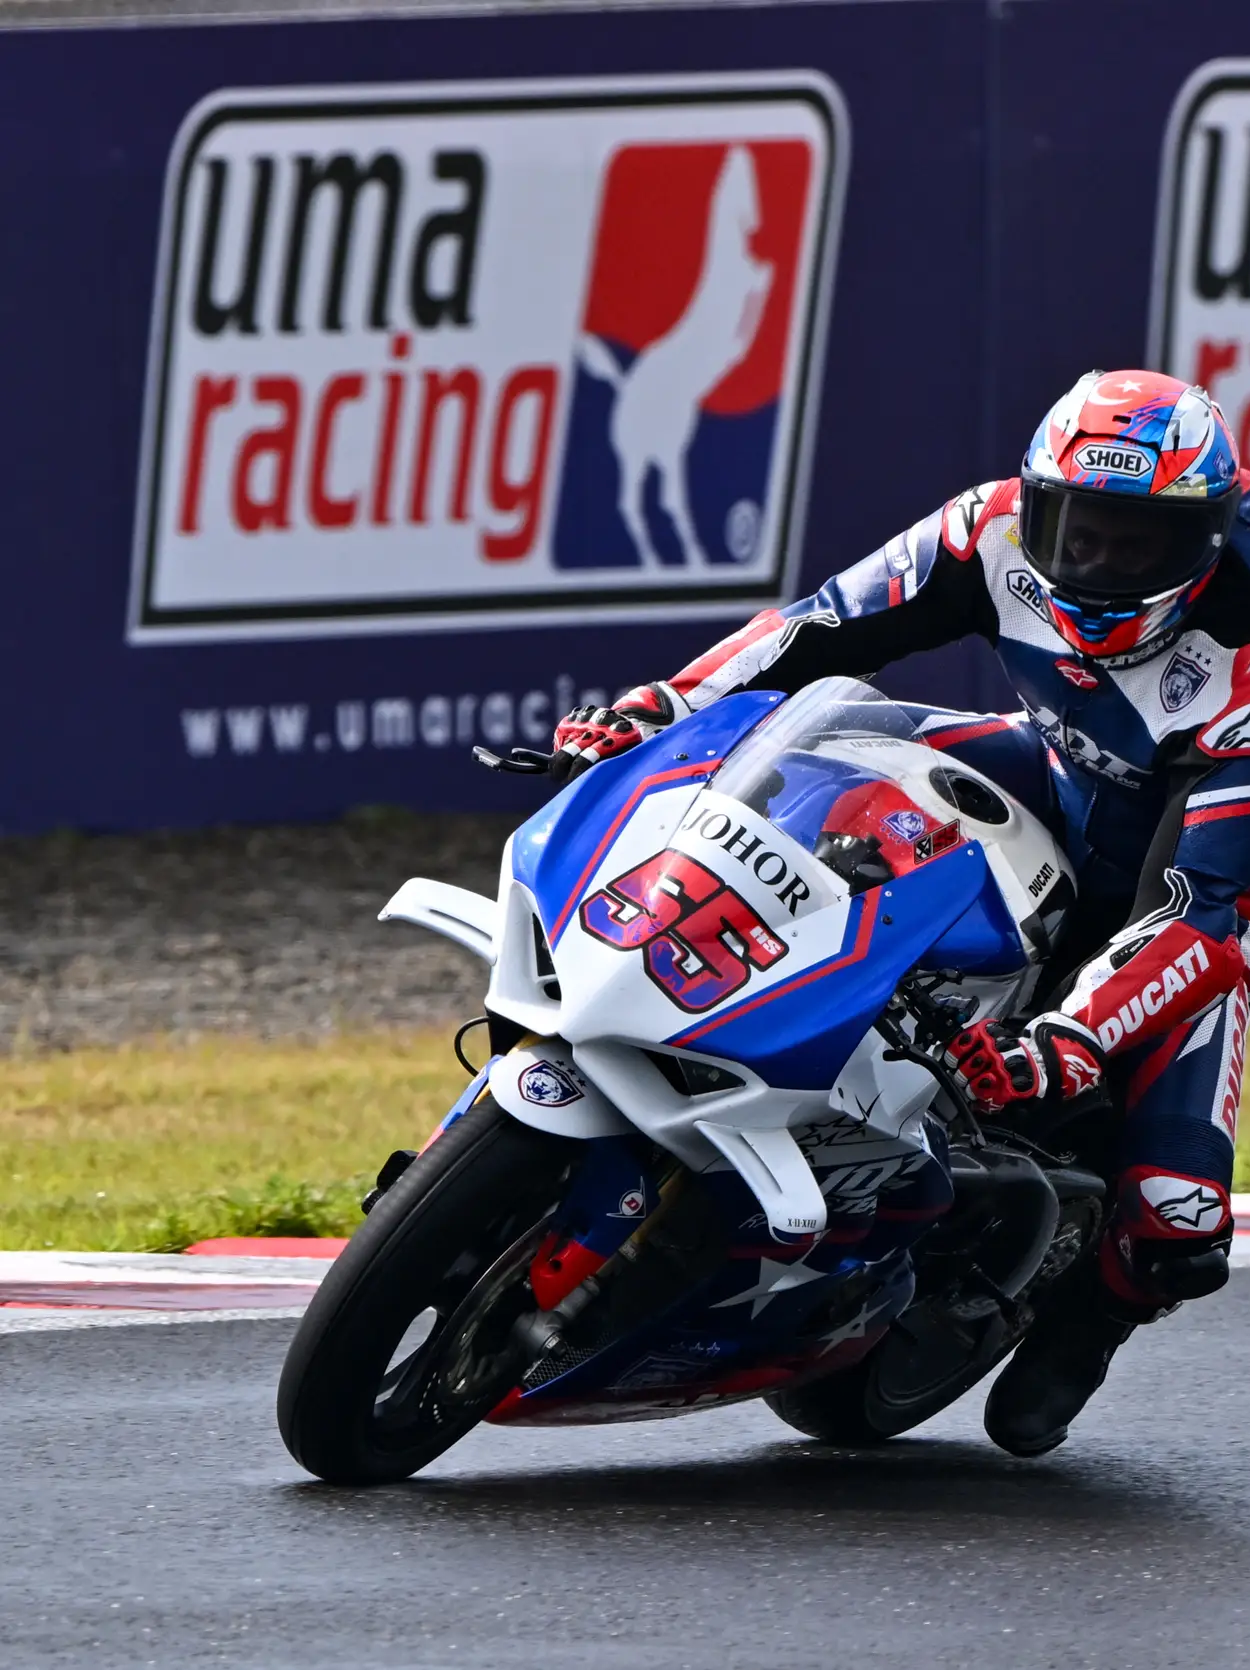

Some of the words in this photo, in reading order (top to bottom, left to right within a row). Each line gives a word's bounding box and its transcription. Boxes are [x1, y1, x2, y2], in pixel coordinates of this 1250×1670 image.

[192, 147, 486, 337] uma
[176, 333, 560, 566] racing
[1084, 447, 1143, 472] SHOEI
[1012, 575, 1043, 611] SHO
[180, 674, 638, 759] www.umaraci
[682, 806, 811, 917] JOHOR
[1028, 862, 1055, 898] DUCATI
[579, 847, 790, 1014] 55
[1098, 939, 1210, 1053] DUCATI
